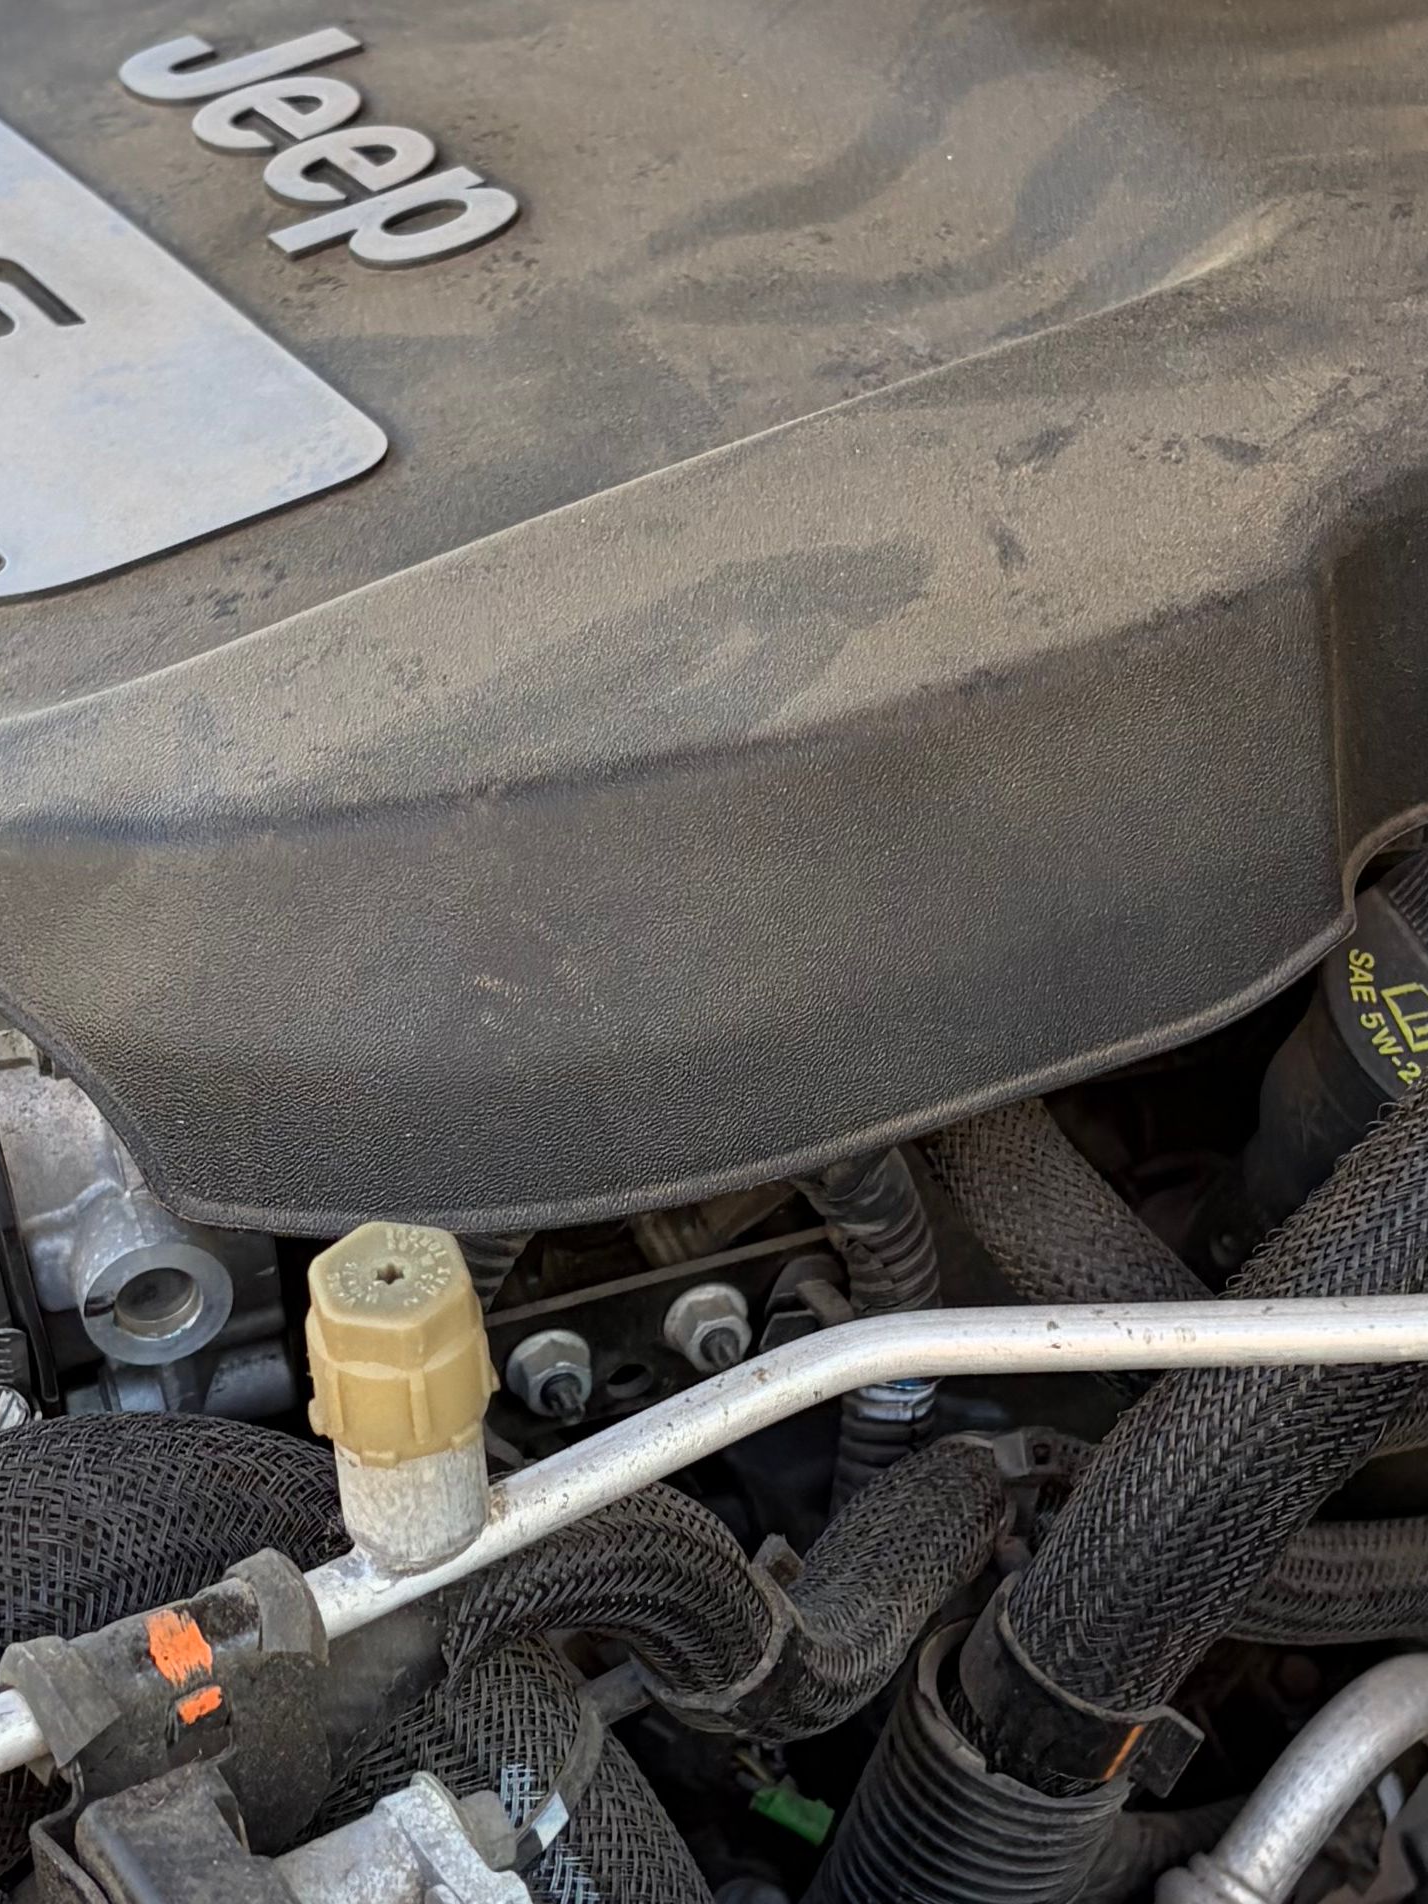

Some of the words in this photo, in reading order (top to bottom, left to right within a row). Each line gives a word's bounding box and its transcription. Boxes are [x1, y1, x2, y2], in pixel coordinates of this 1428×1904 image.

[119, 26, 518, 270] Jeep
[1348, 948, 1377, 1003] SAE
[1360, 1012, 1422, 1085] 5W-2
